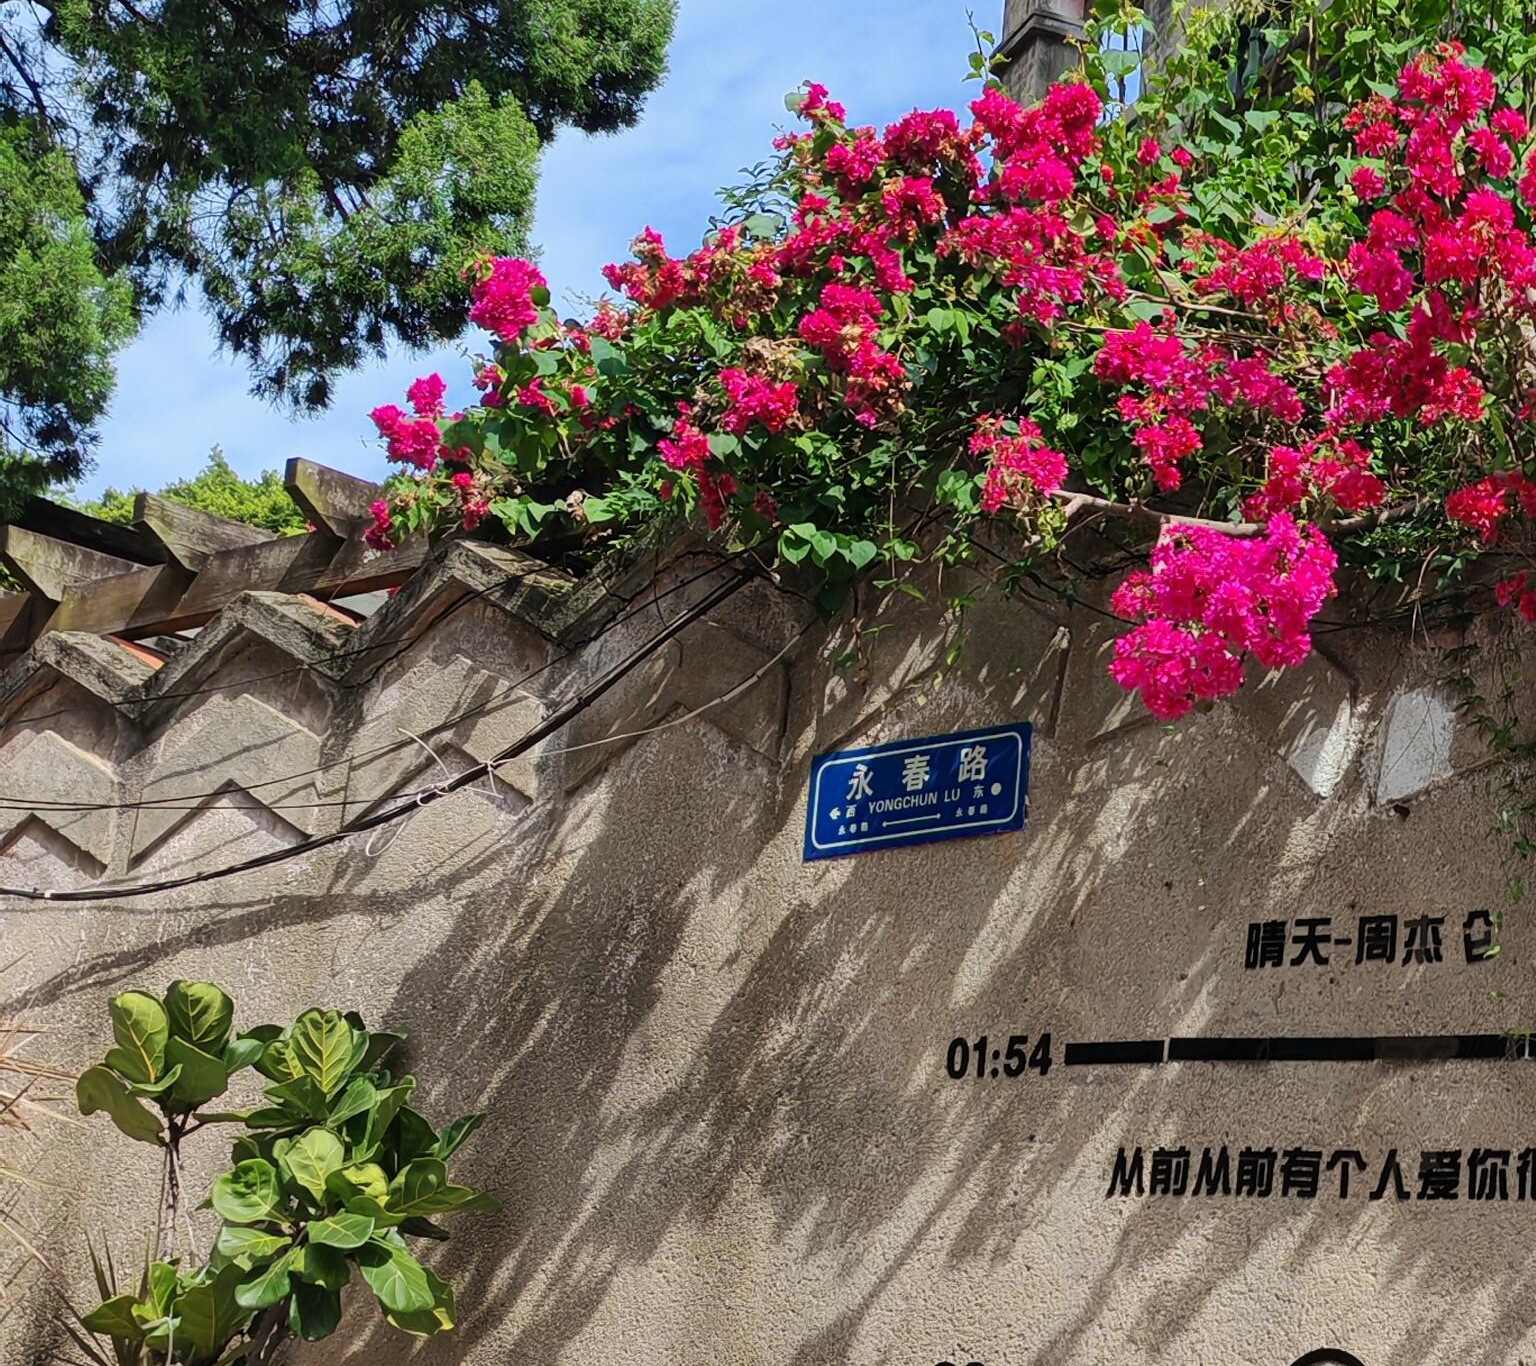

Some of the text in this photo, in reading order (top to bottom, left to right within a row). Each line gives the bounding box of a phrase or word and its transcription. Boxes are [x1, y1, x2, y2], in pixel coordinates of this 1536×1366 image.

[846, 745, 988, 801] 永春路
[868, 788, 961, 814] YONGCHUN LU
[972, 784, 985, 799] 东
[845, 804, 857, 819] 西
[946, 1033, 1052, 1080] 01:54
